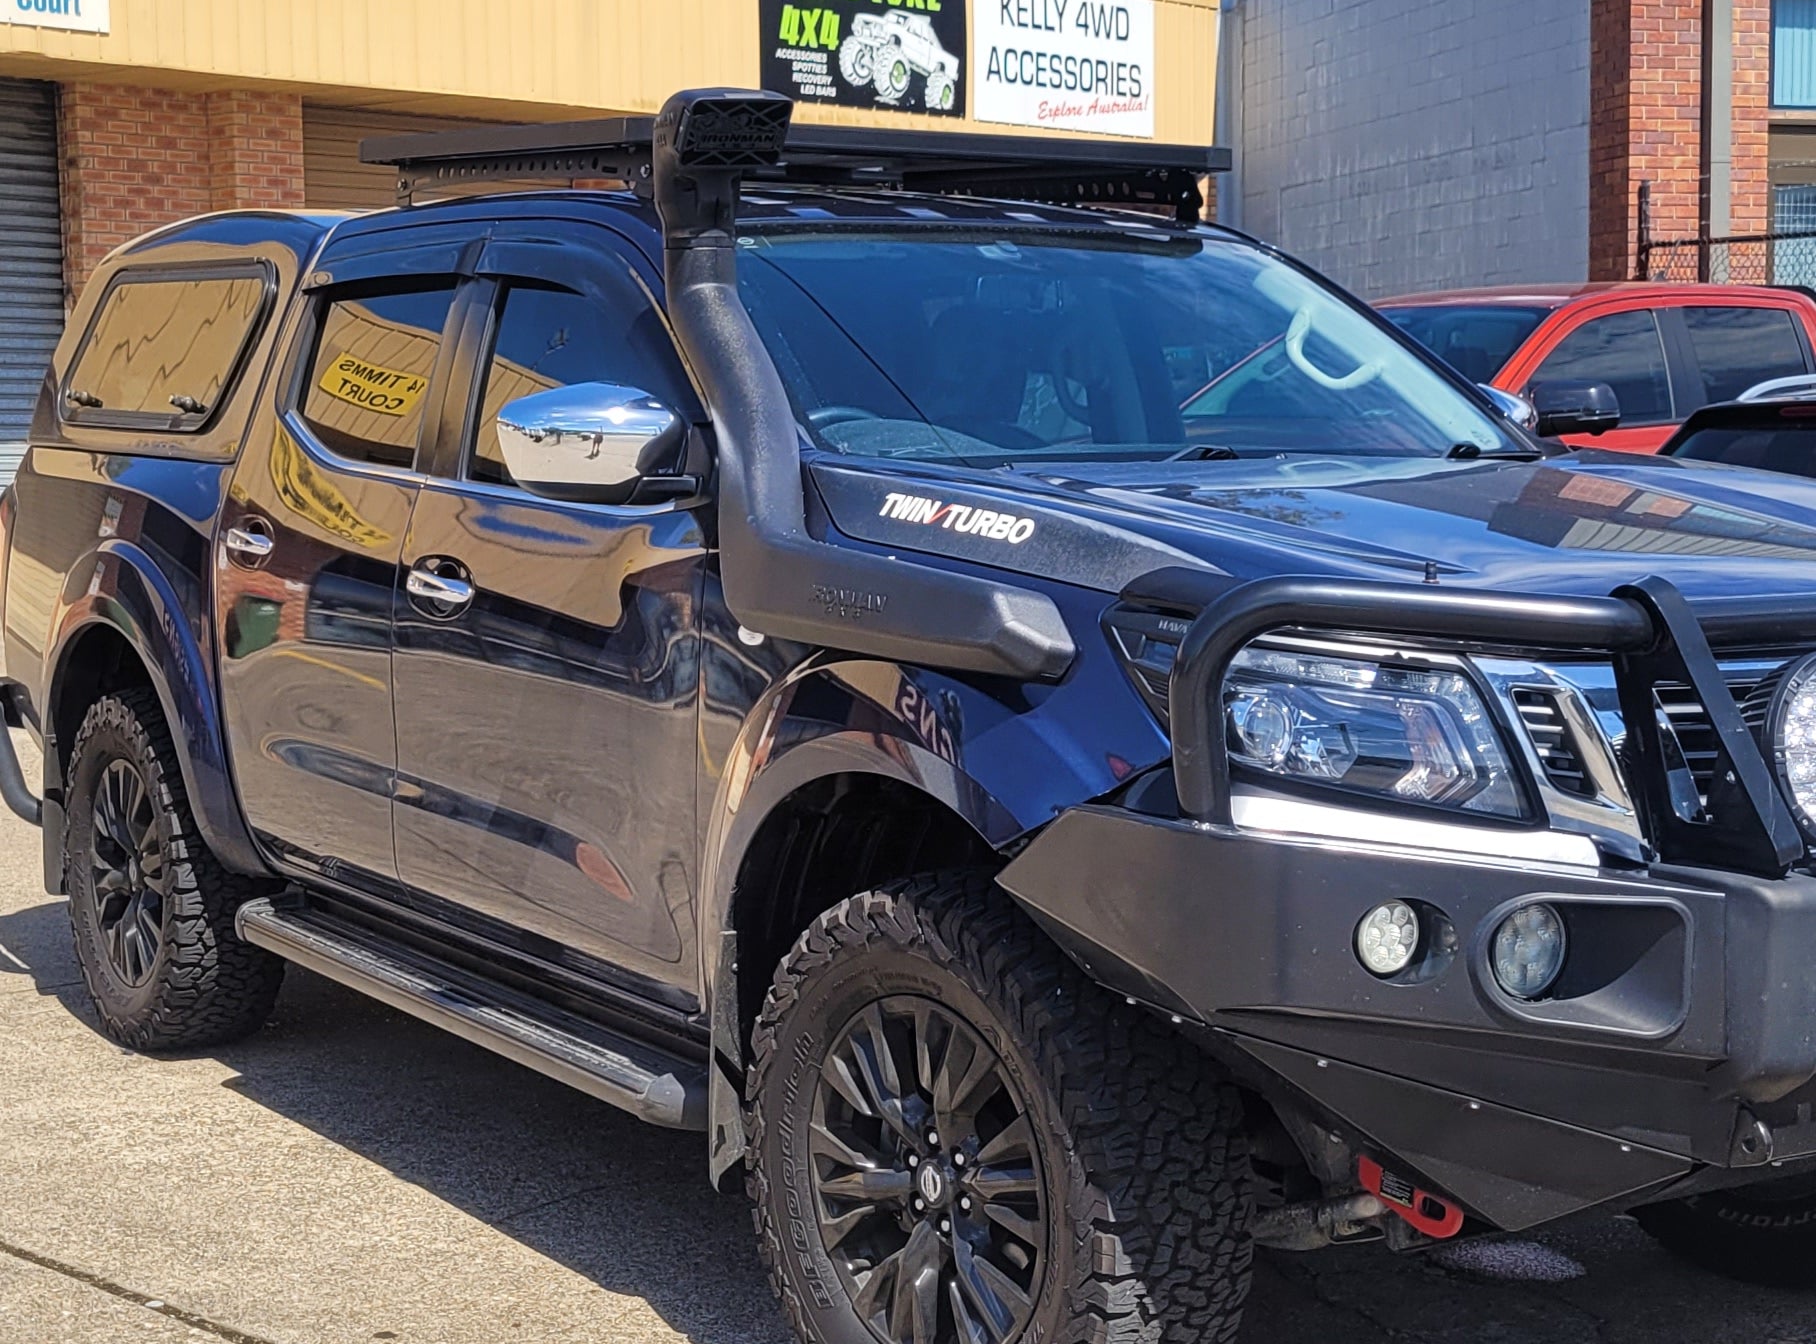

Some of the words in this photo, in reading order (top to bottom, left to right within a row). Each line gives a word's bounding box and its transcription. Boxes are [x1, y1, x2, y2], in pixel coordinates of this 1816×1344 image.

[779, 4, 840, 50] 4X4
[1076, 1, 1130, 41] 4WD
[775, 48, 828, 63] ACCESSORIES
[792, 72, 832, 86] RECOVERY
[986, 46, 1142, 98] ACCESSORIES
[800, 84, 815, 95] LED
[816, 86, 836, 97] BARS
[1037, 101, 1083, 122] Explore
[1087, 94, 1149, 116] Australia!
[1158, 619, 1188, 634] NAVA
[778, 1031, 834, 1308] BFGoodrich
